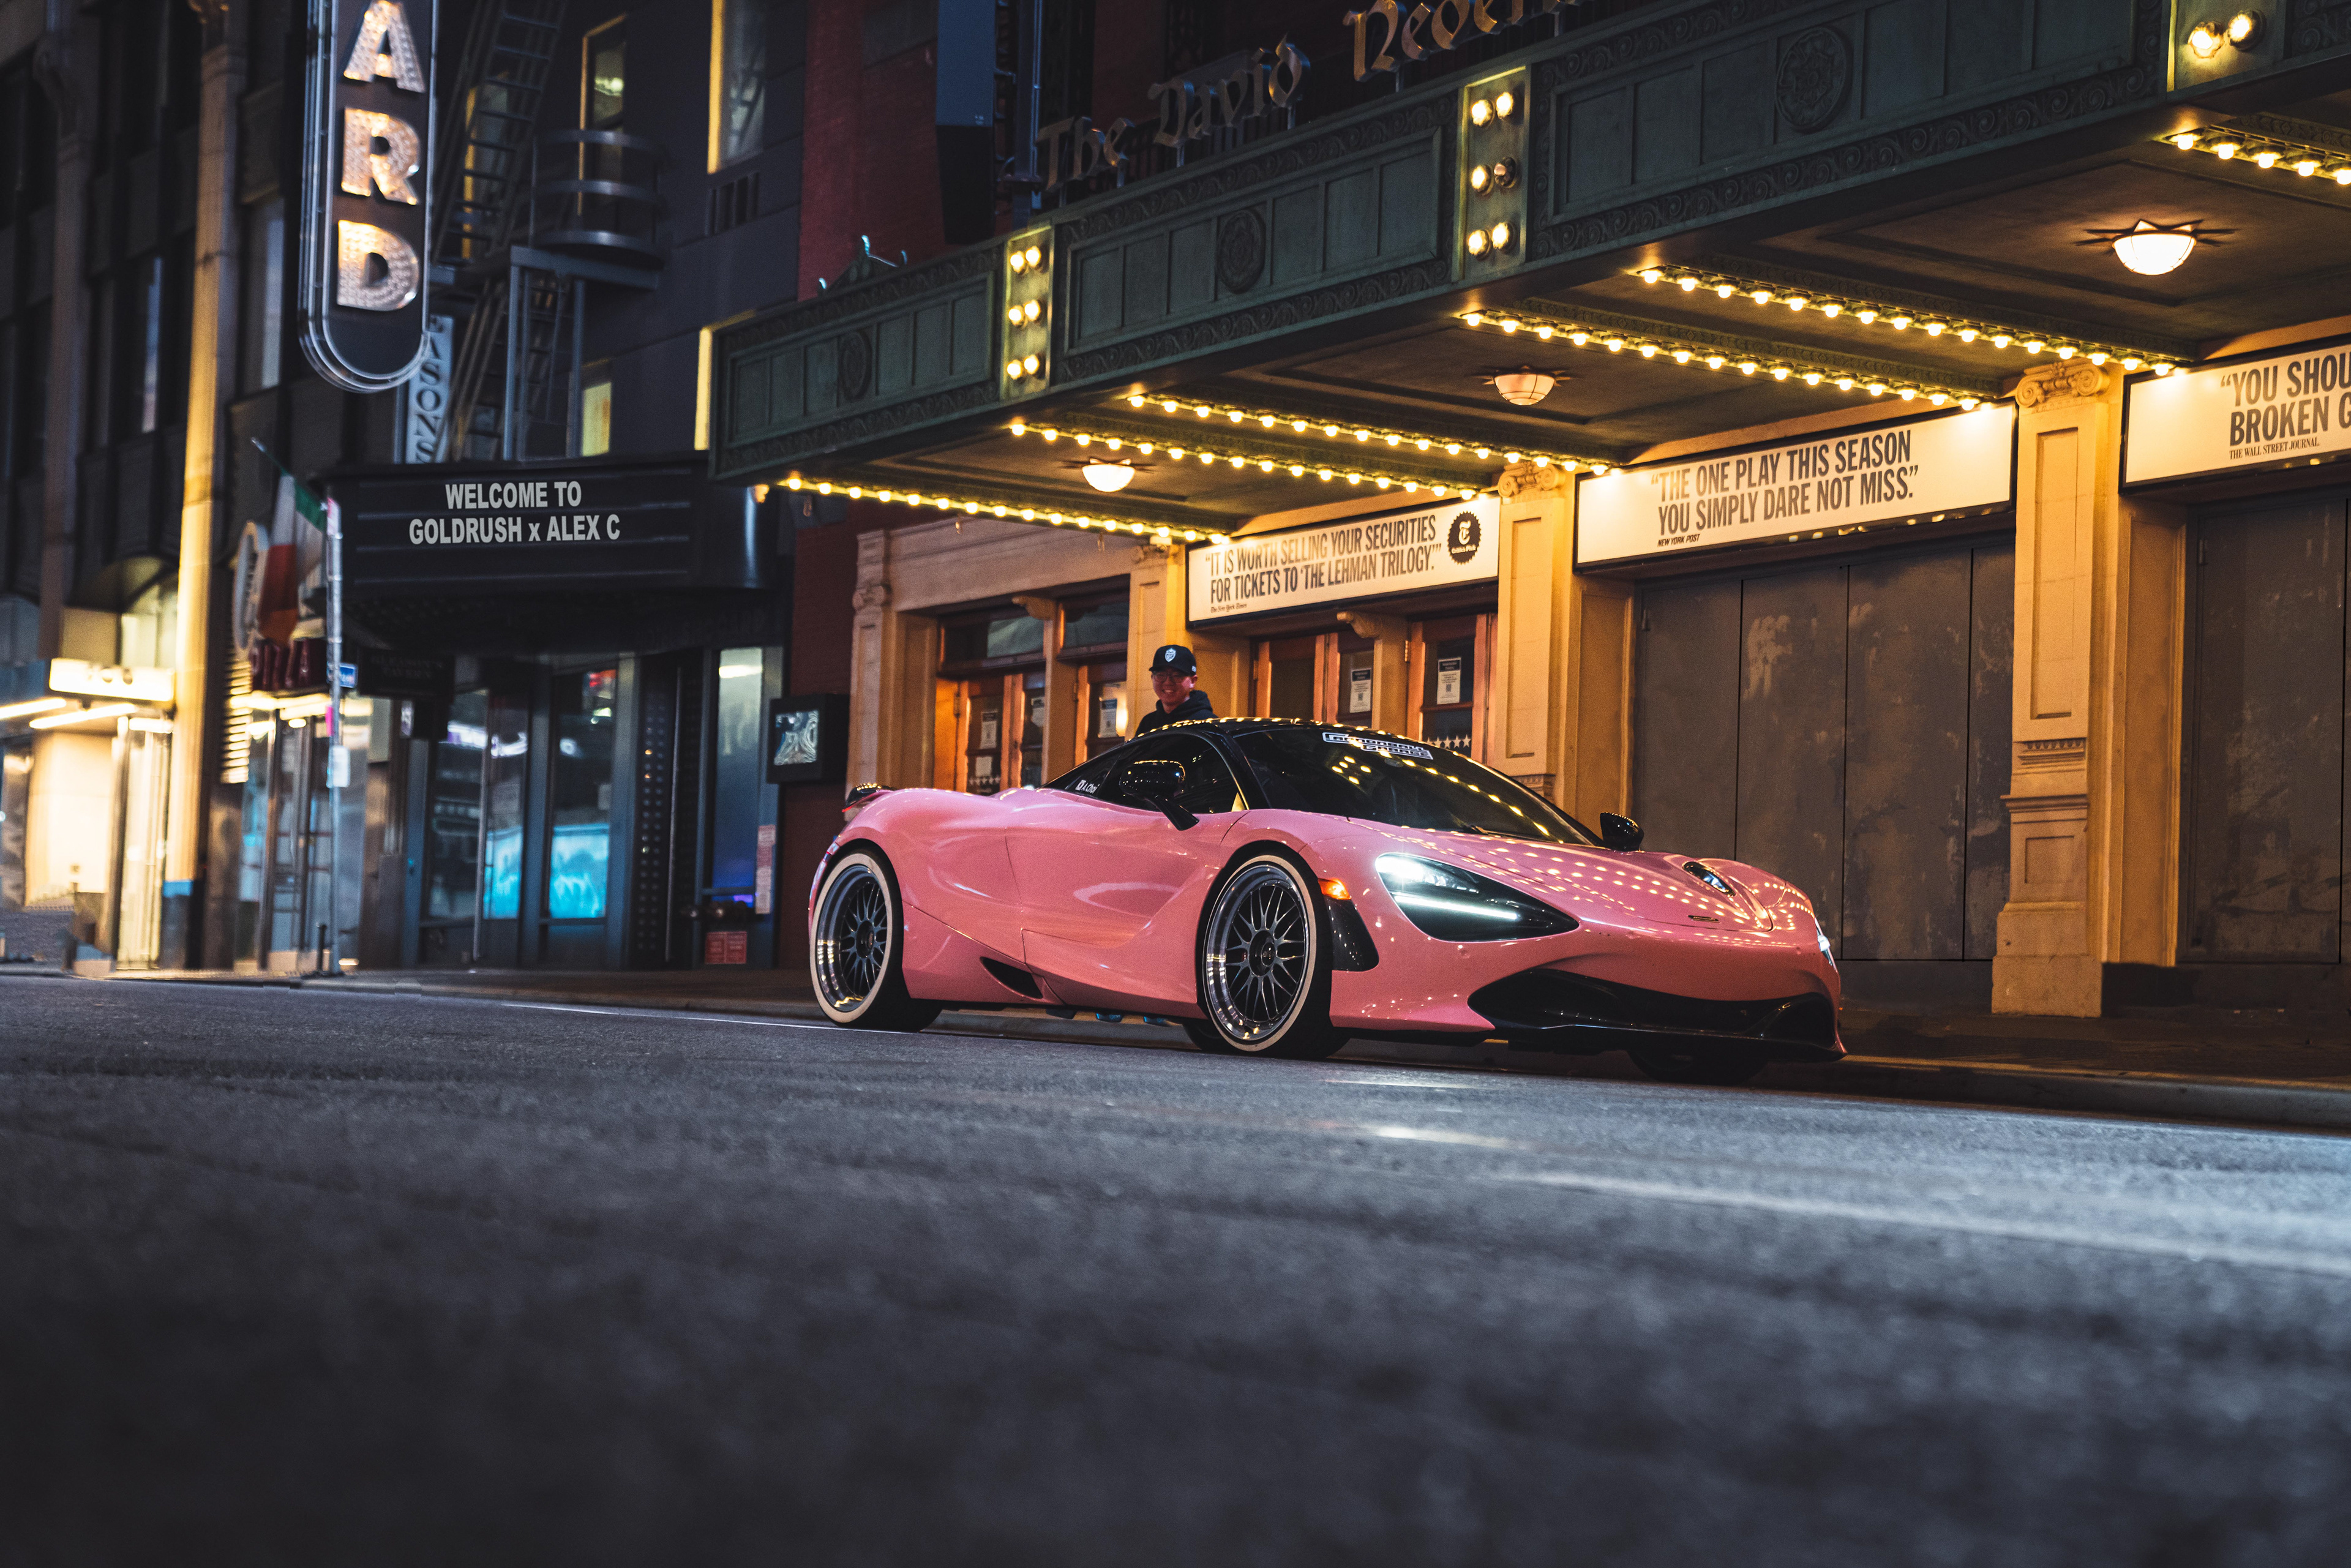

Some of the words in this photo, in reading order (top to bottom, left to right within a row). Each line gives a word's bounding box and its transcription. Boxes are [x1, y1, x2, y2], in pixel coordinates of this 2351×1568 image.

[1034, 116, 1134, 193] The
[1147, 33, 1311, 149] David
[2230, 396, 2330, 446] BROKEN
[1696, 462, 1730, 497] ONE
[1736, 452, 1780, 490] PLAY
[1787, 445, 1829, 481] THIS
[1835, 430, 1911, 473] SEASON
[2229, 449, 2243, 459] THE
[2244, 446, 2261, 457] WALL
[2263, 441, 2288, 454] STREET
[445, 482, 548, 509] WELCOME
[554, 481, 582, 507] TO
[1658, 502, 1690, 536] YOU
[1696, 491, 1758, 531] SIMPLY
[1763, 482, 1810, 521] DARE
[1817, 476, 1854, 512] NOT
[409, 517, 522, 545] GOLDRUSH
[547, 515, 601, 541] ALEX
[606, 514, 620, 540] C
[1224, 550, 1234, 574] IS
[1237, 542, 1277, 571] WORTH
[1281, 533, 1328, 565] SELLING
[1331, 528, 1362, 557] YOUR
[1365, 515, 1436, 552] SECURITIES
[1657, 538, 1670, 547] NEW
[1671, 536, 1685, 545] YORK
[1685, 534, 1700, 542] POST
[1211, 577, 1231, 604] FOR
[1234, 569, 1280, 599] TICKETS
[1284, 566, 1298, 593] TO
[1327, 553, 1376, 586] LEHMAN
